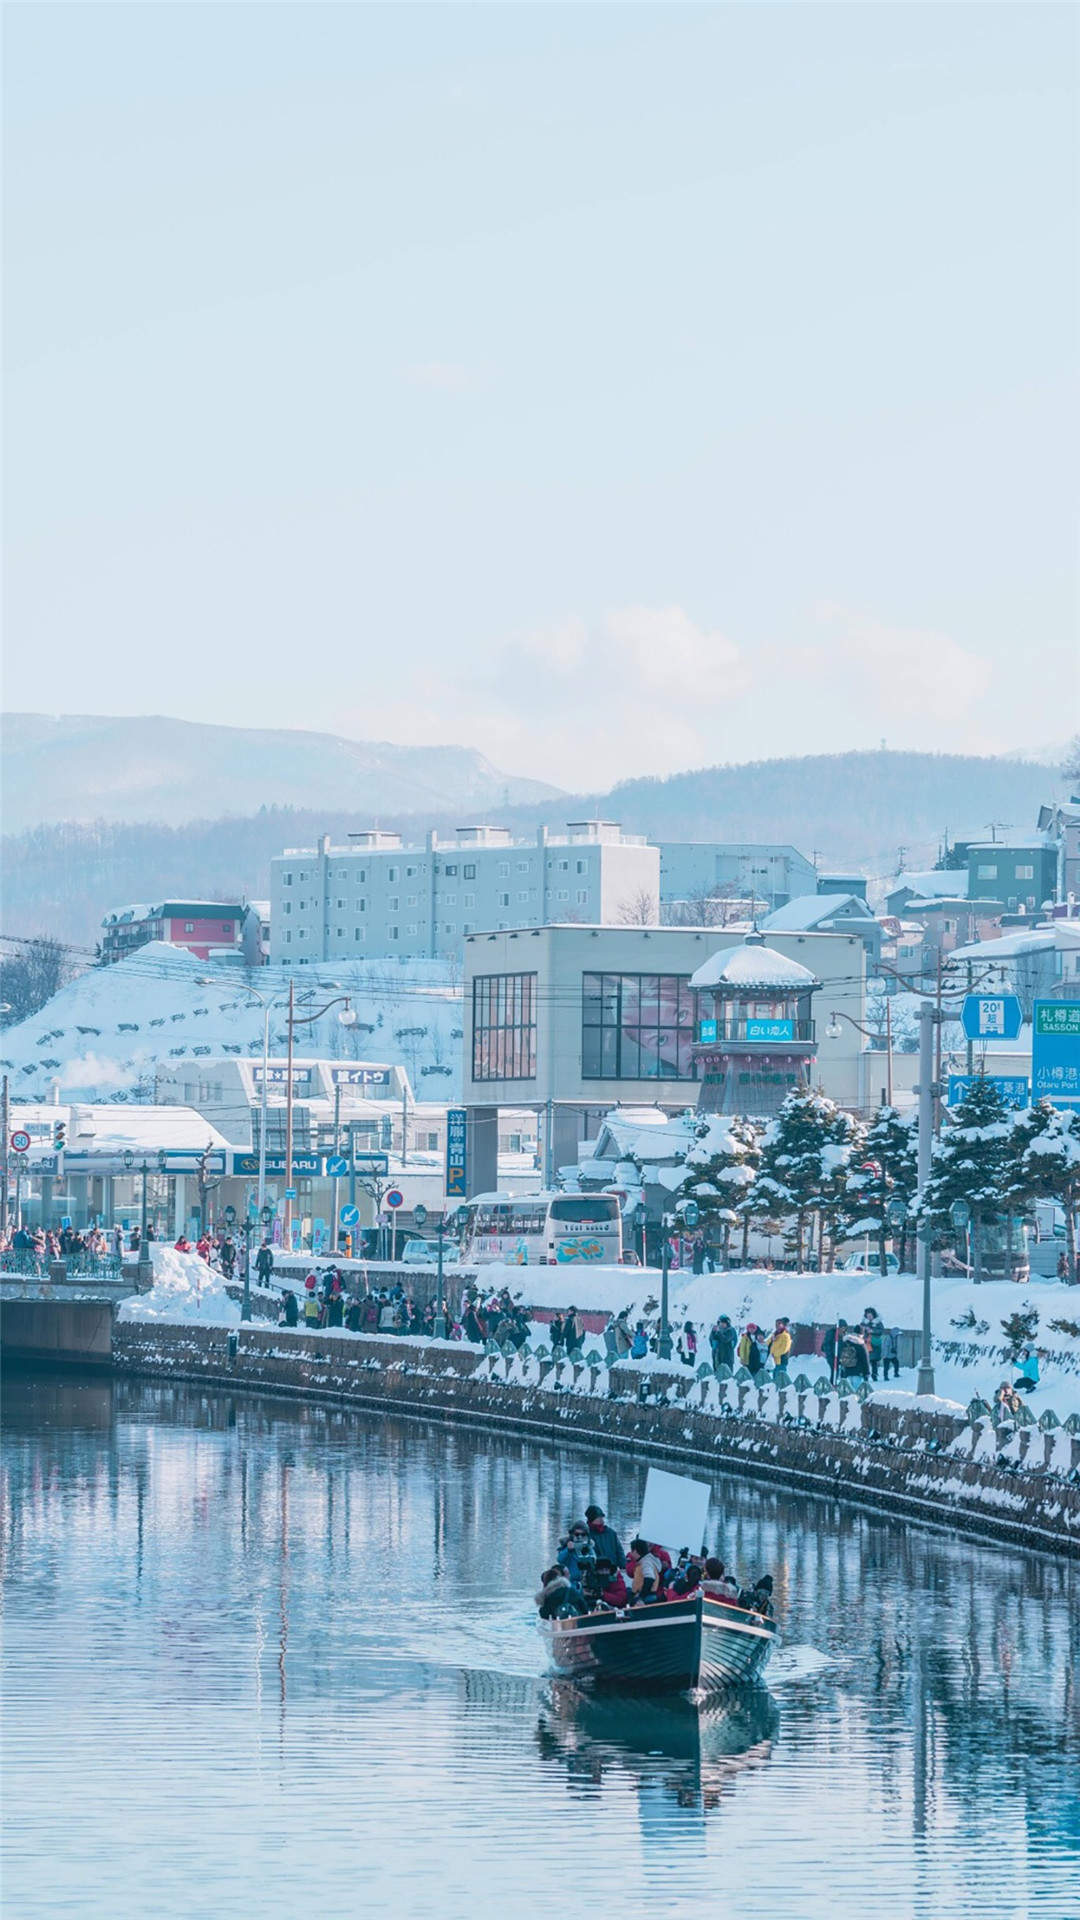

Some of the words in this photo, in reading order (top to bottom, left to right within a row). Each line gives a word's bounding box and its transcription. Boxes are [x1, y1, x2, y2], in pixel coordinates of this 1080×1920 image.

[750, 1026, 790, 1036] 白い恋人
[1043, 1023, 1079, 1032] SASSON
[1037, 1080, 1059, 1088] Otaru
[1061, 1080, 1078, 1088] Port
[264, 1160, 316, 1169] SUBARU
[449, 1167, 464, 1184] P
